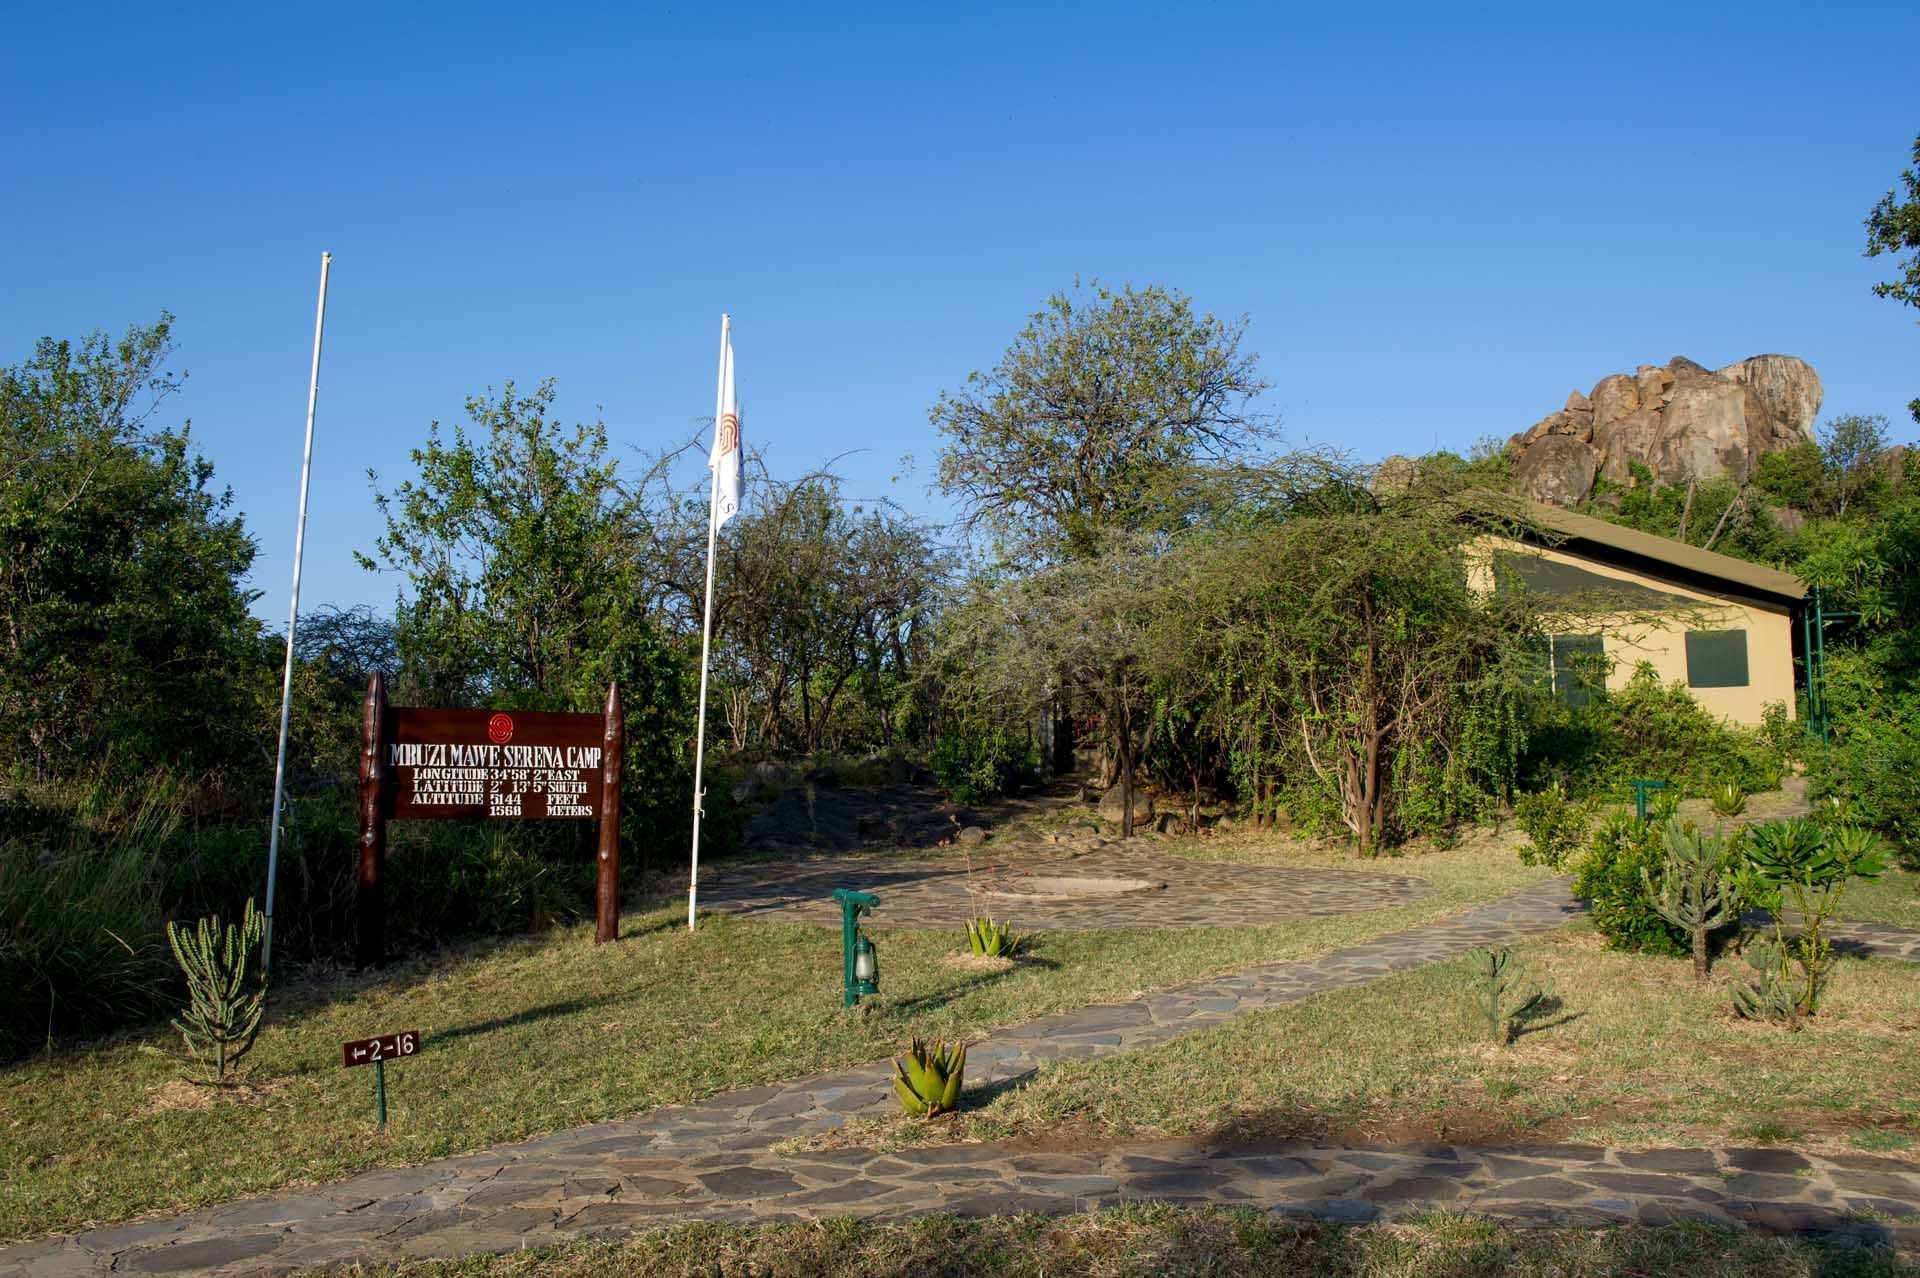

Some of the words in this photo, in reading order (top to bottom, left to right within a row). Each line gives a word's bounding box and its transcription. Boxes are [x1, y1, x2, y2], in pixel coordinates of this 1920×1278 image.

[389, 743, 446, 766] MBUZI
[450, 744, 500, 767] MAWE
[504, 745, 564, 768] SERENA
[567, 746, 601, 769] CAMP
[413, 767, 488, 780] LONGITUDE
[413, 780, 484, 792] LATITUDE
[548, 781, 587, 793] SOUTH
[411, 793, 484, 805] ALTITUDE
[490, 793, 522, 805] 5144
[546, 793, 580, 805] FEET
[489, 805, 522, 816] 1568
[546, 805, 593, 817] METERS
